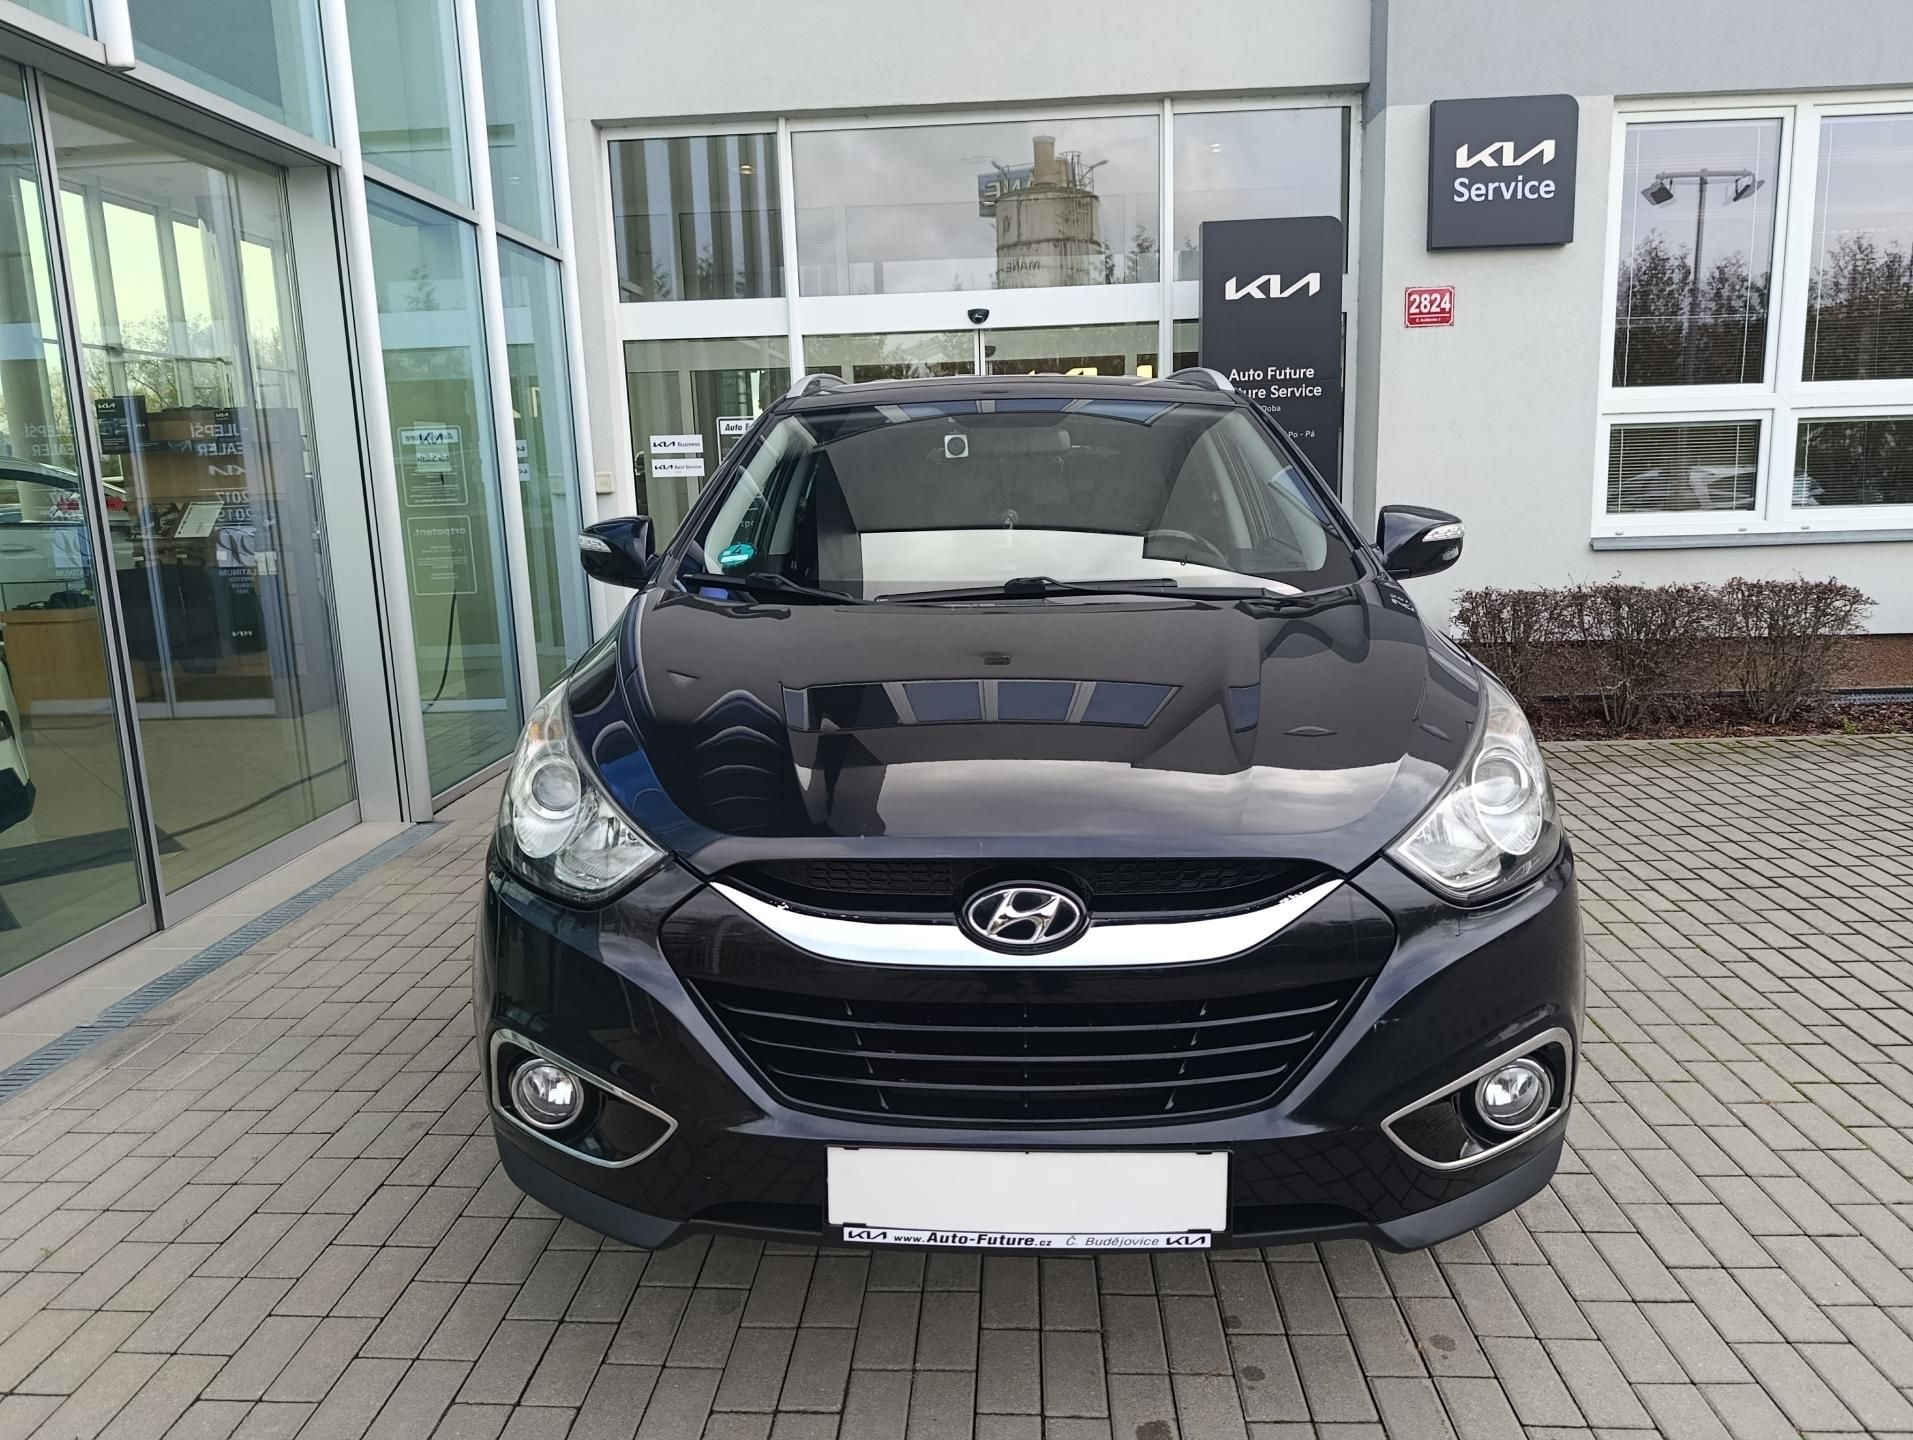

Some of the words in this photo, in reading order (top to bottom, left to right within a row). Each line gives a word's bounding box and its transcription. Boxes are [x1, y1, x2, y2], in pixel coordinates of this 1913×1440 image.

[1456, 139, 1556, 168] KIA
[1453, 175, 1556, 202] Service
[1225, 272, 1321, 301] KIA
[1409, 293, 1451, 314] 2824
[1229, 368, 1263, 381] Auto
[1267, 367, 1315, 380] Future
[1270, 384, 1322, 398] Service
[725, 423, 743, 431] Auto
[848, 1230, 888, 1240] KIA
[1065, 1235, 1079, 1246] Č.
[1085, 1236, 1160, 1247] Budějovice
[1166, 1236, 1206, 1246] KIA
